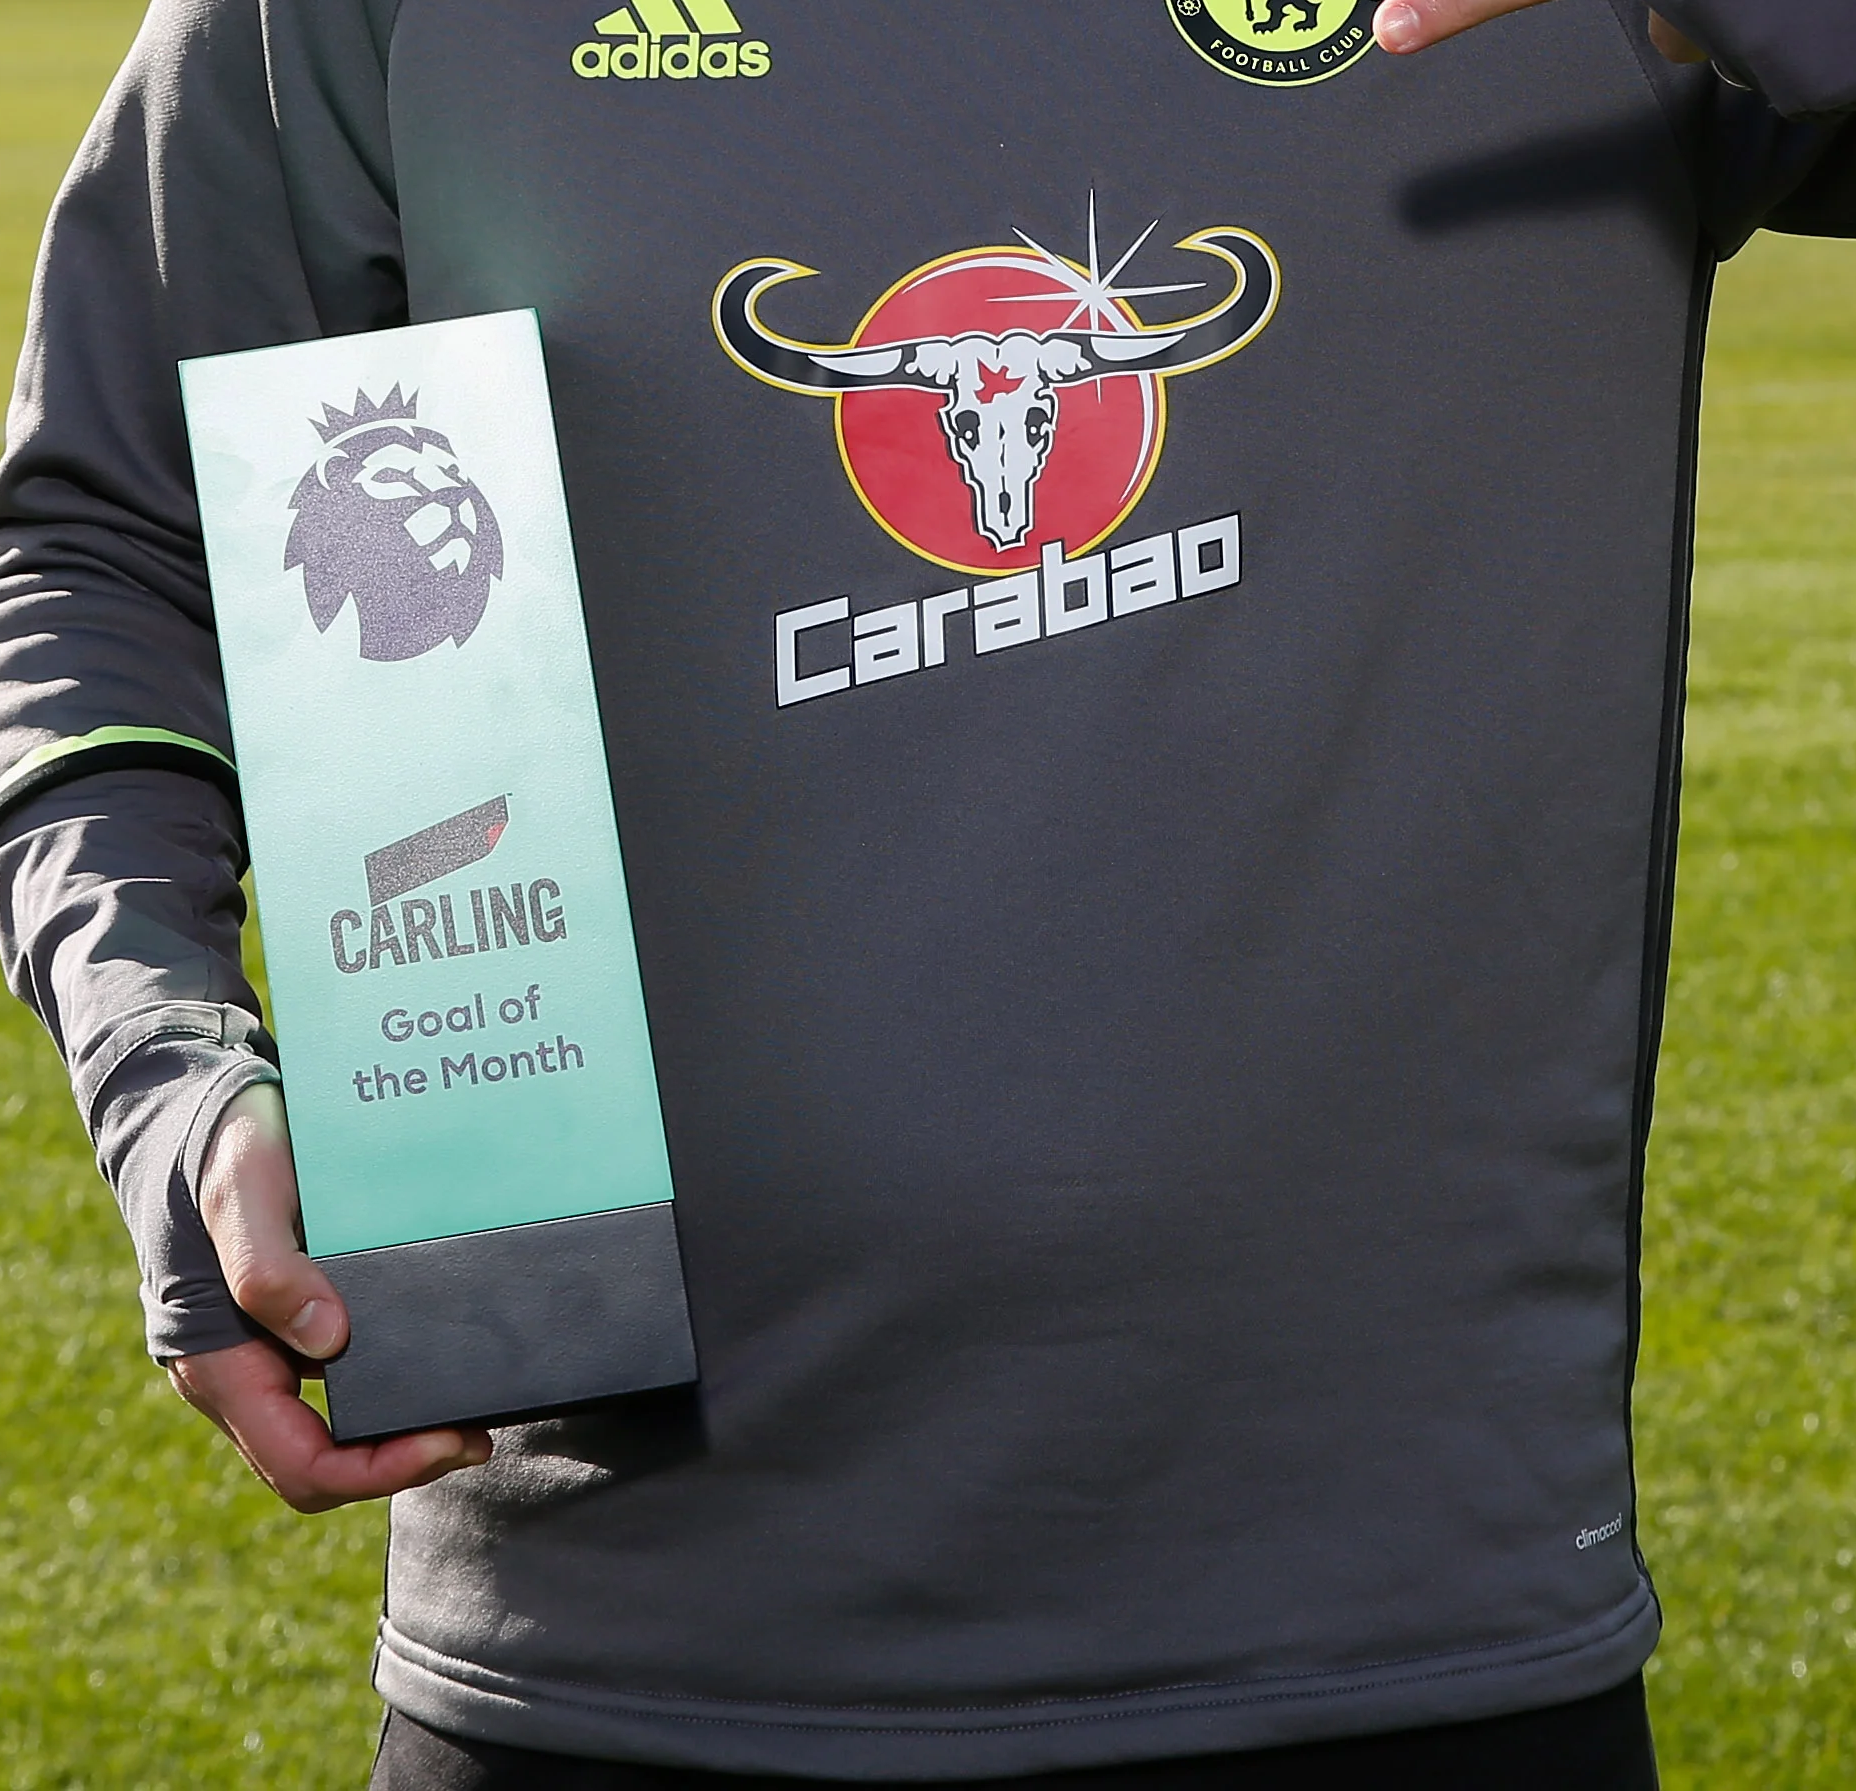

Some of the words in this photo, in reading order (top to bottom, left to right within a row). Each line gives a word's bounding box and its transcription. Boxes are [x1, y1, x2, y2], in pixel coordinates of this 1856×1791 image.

[571, 32, 772, 79] adidas
[1210, 39, 1311, 74] FOOTBALL
[1319, 26, 1365, 63] CLUB
[775, 512, 1241, 708] Carabao
[330, 877, 567, 974] CARLING
[381, 993, 486, 1042] Goal
[498, 984, 541, 1024] of
[352, 1064, 428, 1103] the
[440, 1035, 584, 1090] Month
